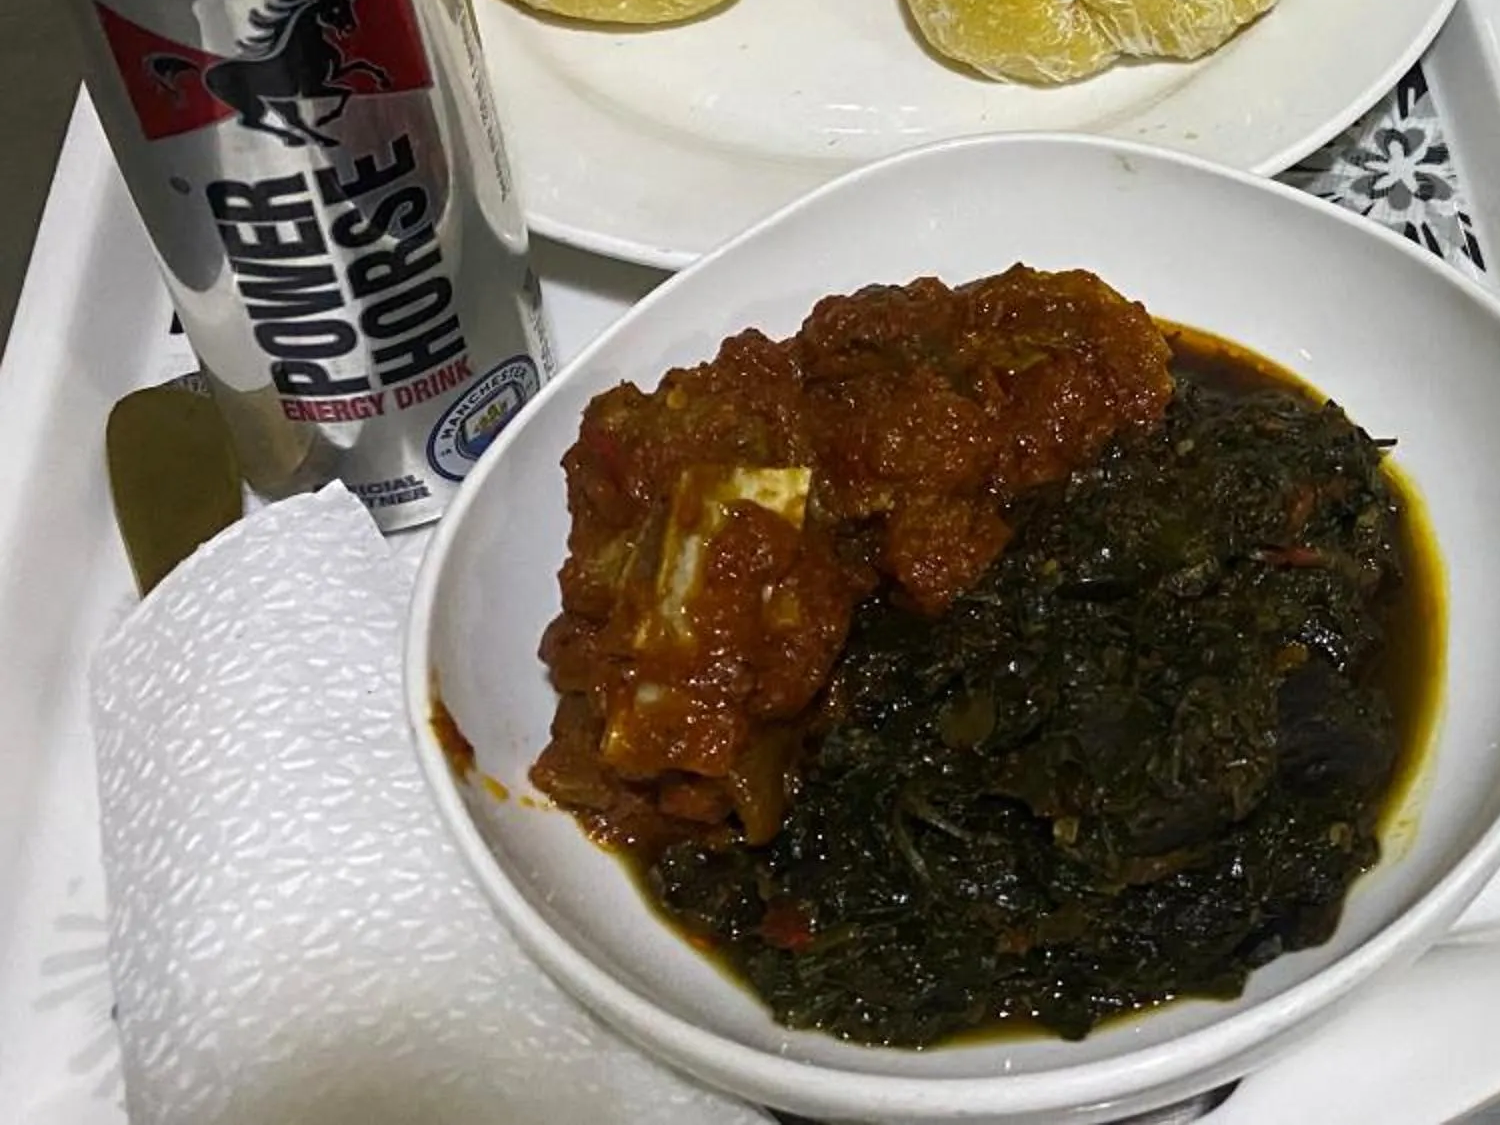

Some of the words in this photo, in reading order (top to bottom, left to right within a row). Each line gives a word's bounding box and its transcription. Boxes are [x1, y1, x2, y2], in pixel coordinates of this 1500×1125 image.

[206, 171, 371, 397] POWER
[312, 133, 468, 387] HORSE
[279, 391, 386, 423] ENERGY
[392, 354, 474, 411] DRINK
